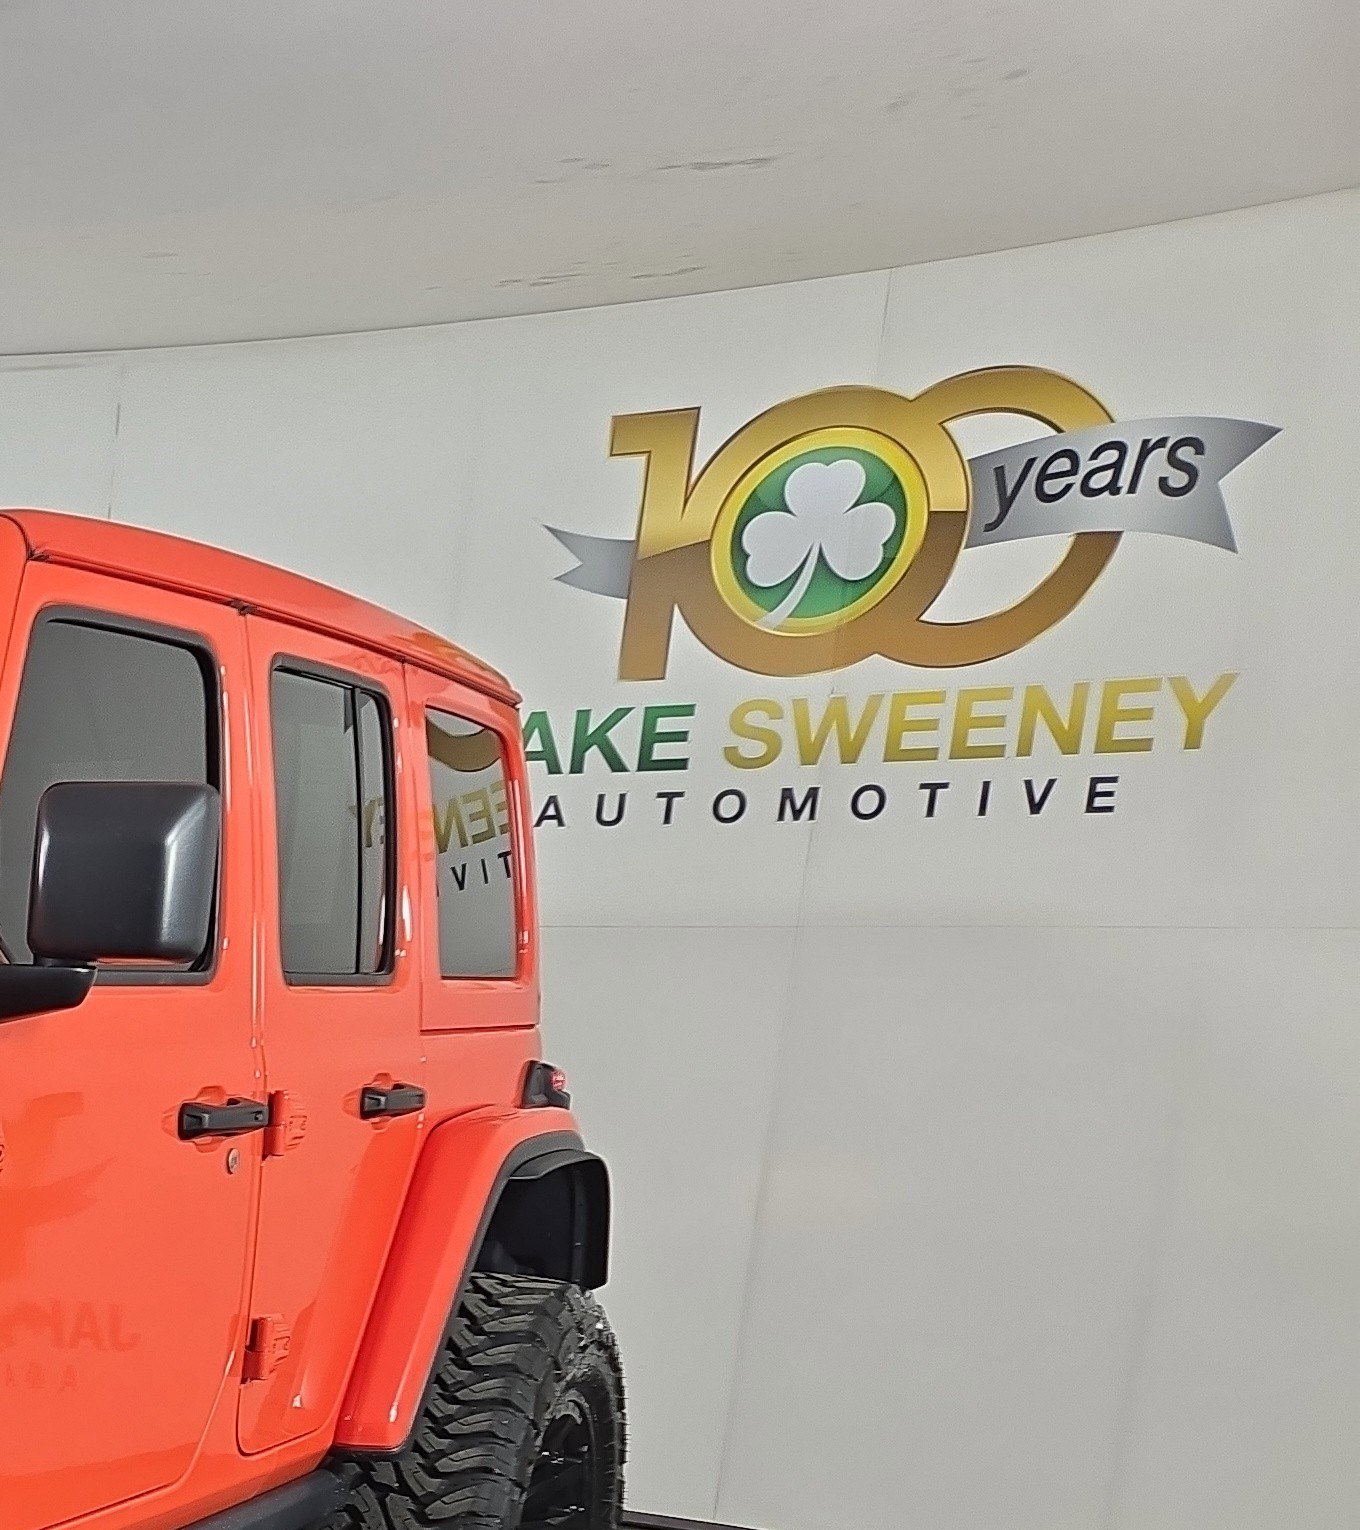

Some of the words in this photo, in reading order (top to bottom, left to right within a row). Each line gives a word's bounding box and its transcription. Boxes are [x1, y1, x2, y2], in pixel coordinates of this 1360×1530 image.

[983, 434, 1207, 532] years
[723, 672, 1241, 770] SWEENEY
[534, 775, 1121, 828] AUTOMOTIVE
